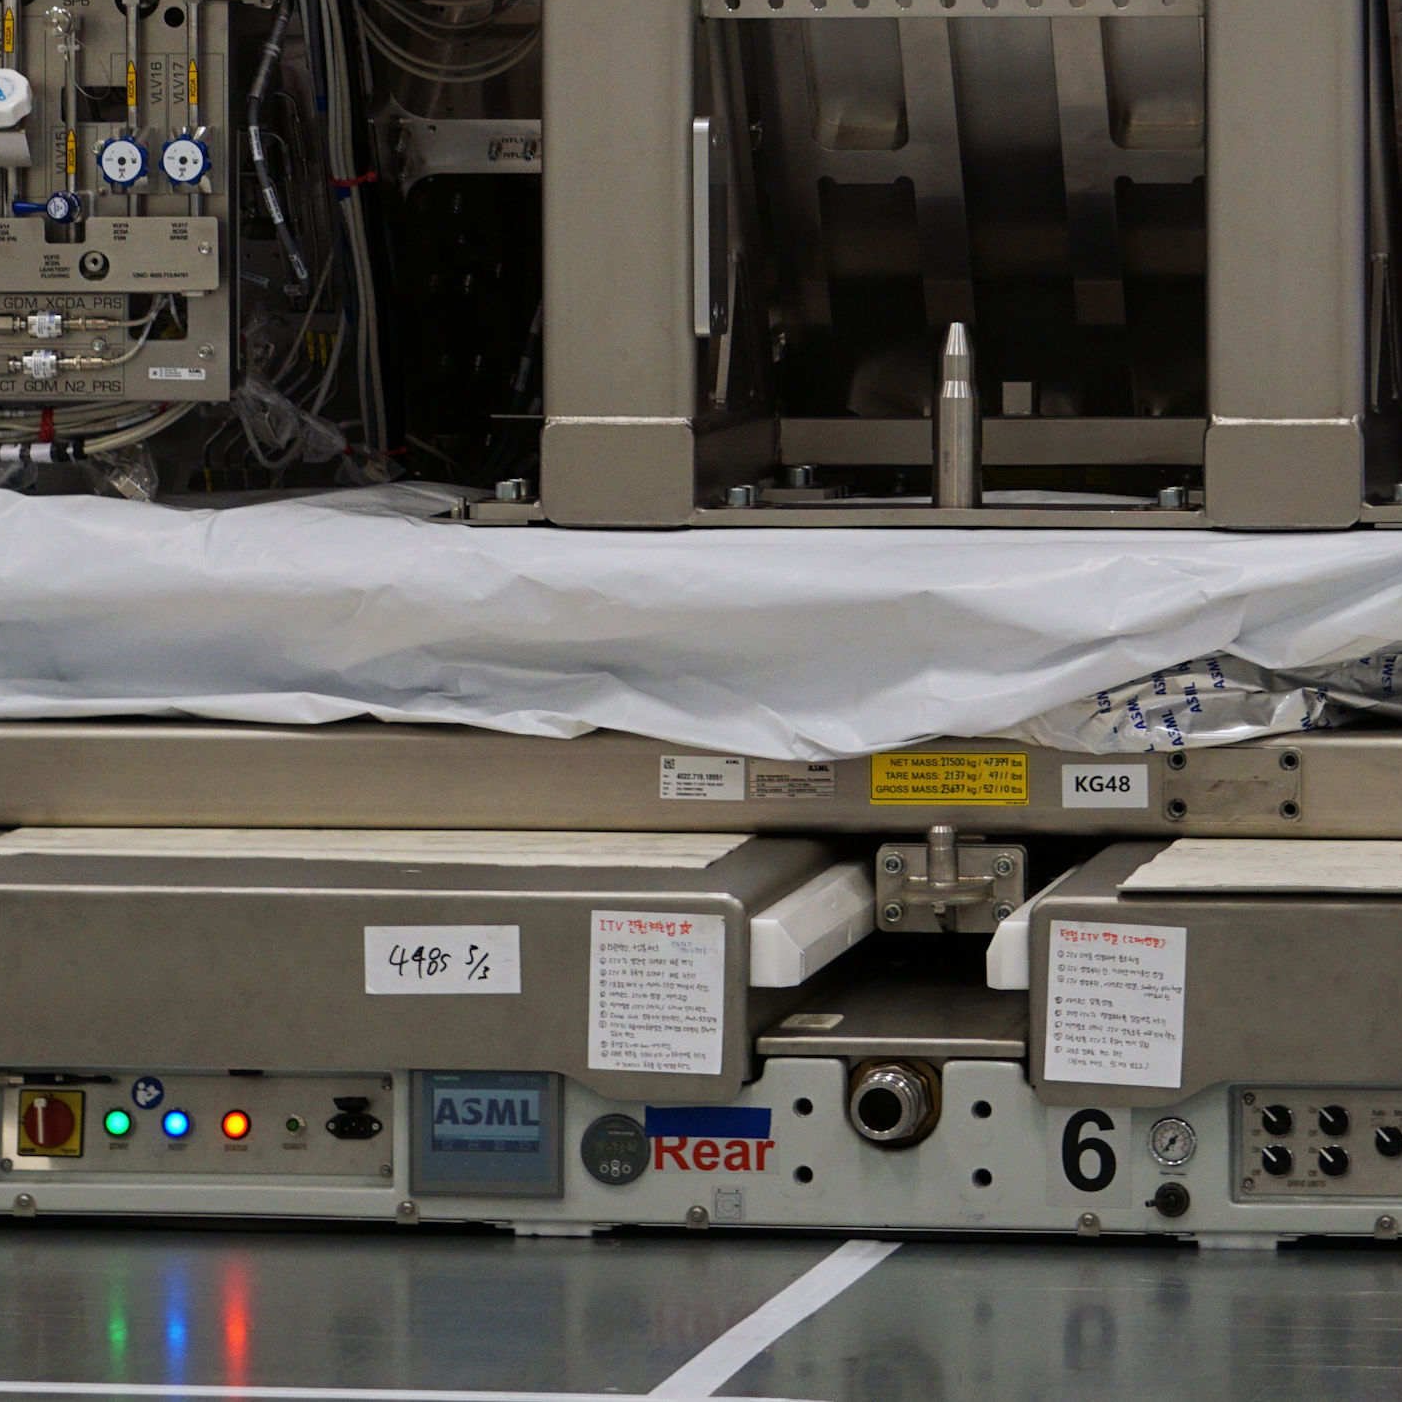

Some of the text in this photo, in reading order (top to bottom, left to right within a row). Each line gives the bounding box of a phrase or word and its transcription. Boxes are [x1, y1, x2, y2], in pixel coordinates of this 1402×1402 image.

[151, 62, 162, 105] VLV16
[173, 63, 184, 105] VLV17
[56, 131, 67, 175] VLV15
[1381, 655, 1398, 692] ASML
[1126, 695, 1147, 729] ASML
[1161, 709, 1184, 747] ASML
[886, 772, 908, 780] TARE
[912, 772, 940, 780] MASS:
[944, 771, 965, 780] 2137
[967, 773, 977, 782] kg
[890, 759, 909, 767] NET
[912, 759, 939, 767] MASS:
[967, 759, 976, 768] kg
[1011, 759, 1022, 767] lbs
[876, 785, 909, 794] GROSS
[912, 785, 939, 793] MASS:
[967, 786, 977, 795] kg
[1011, 786, 1022, 794] lbs
[1075, 776, 1130, 792] KG48
[600, 920, 624, 931] ITV
[1081, 933, 1098, 942] ITV
[434, 1098, 539, 1126] ASML
[655, 1137, 775, 1171] Rear
[1061, 1109, 1117, 1192] 6
